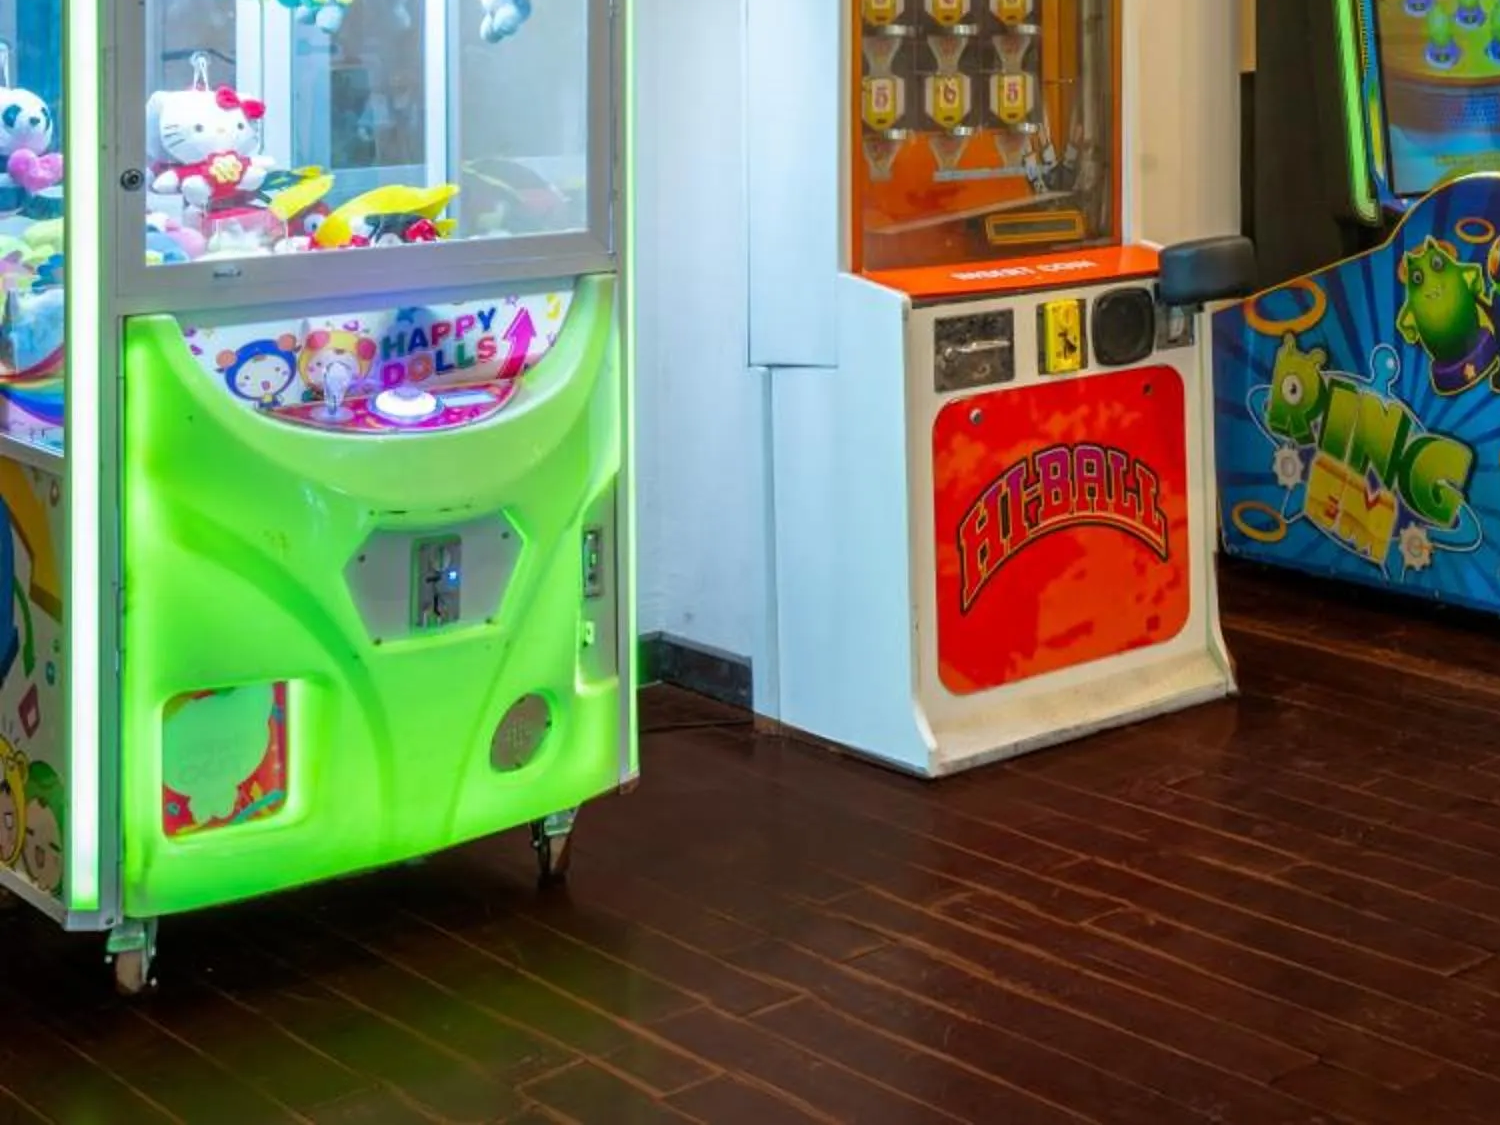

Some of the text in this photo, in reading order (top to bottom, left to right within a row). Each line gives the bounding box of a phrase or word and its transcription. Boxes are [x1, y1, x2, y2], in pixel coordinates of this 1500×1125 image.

[380, 307, 497, 363] HAPPY
[380, 336, 498, 390] DOLLS
[1264, 331, 1477, 532] RING
[957, 440, 1169, 617] HI-BALL
